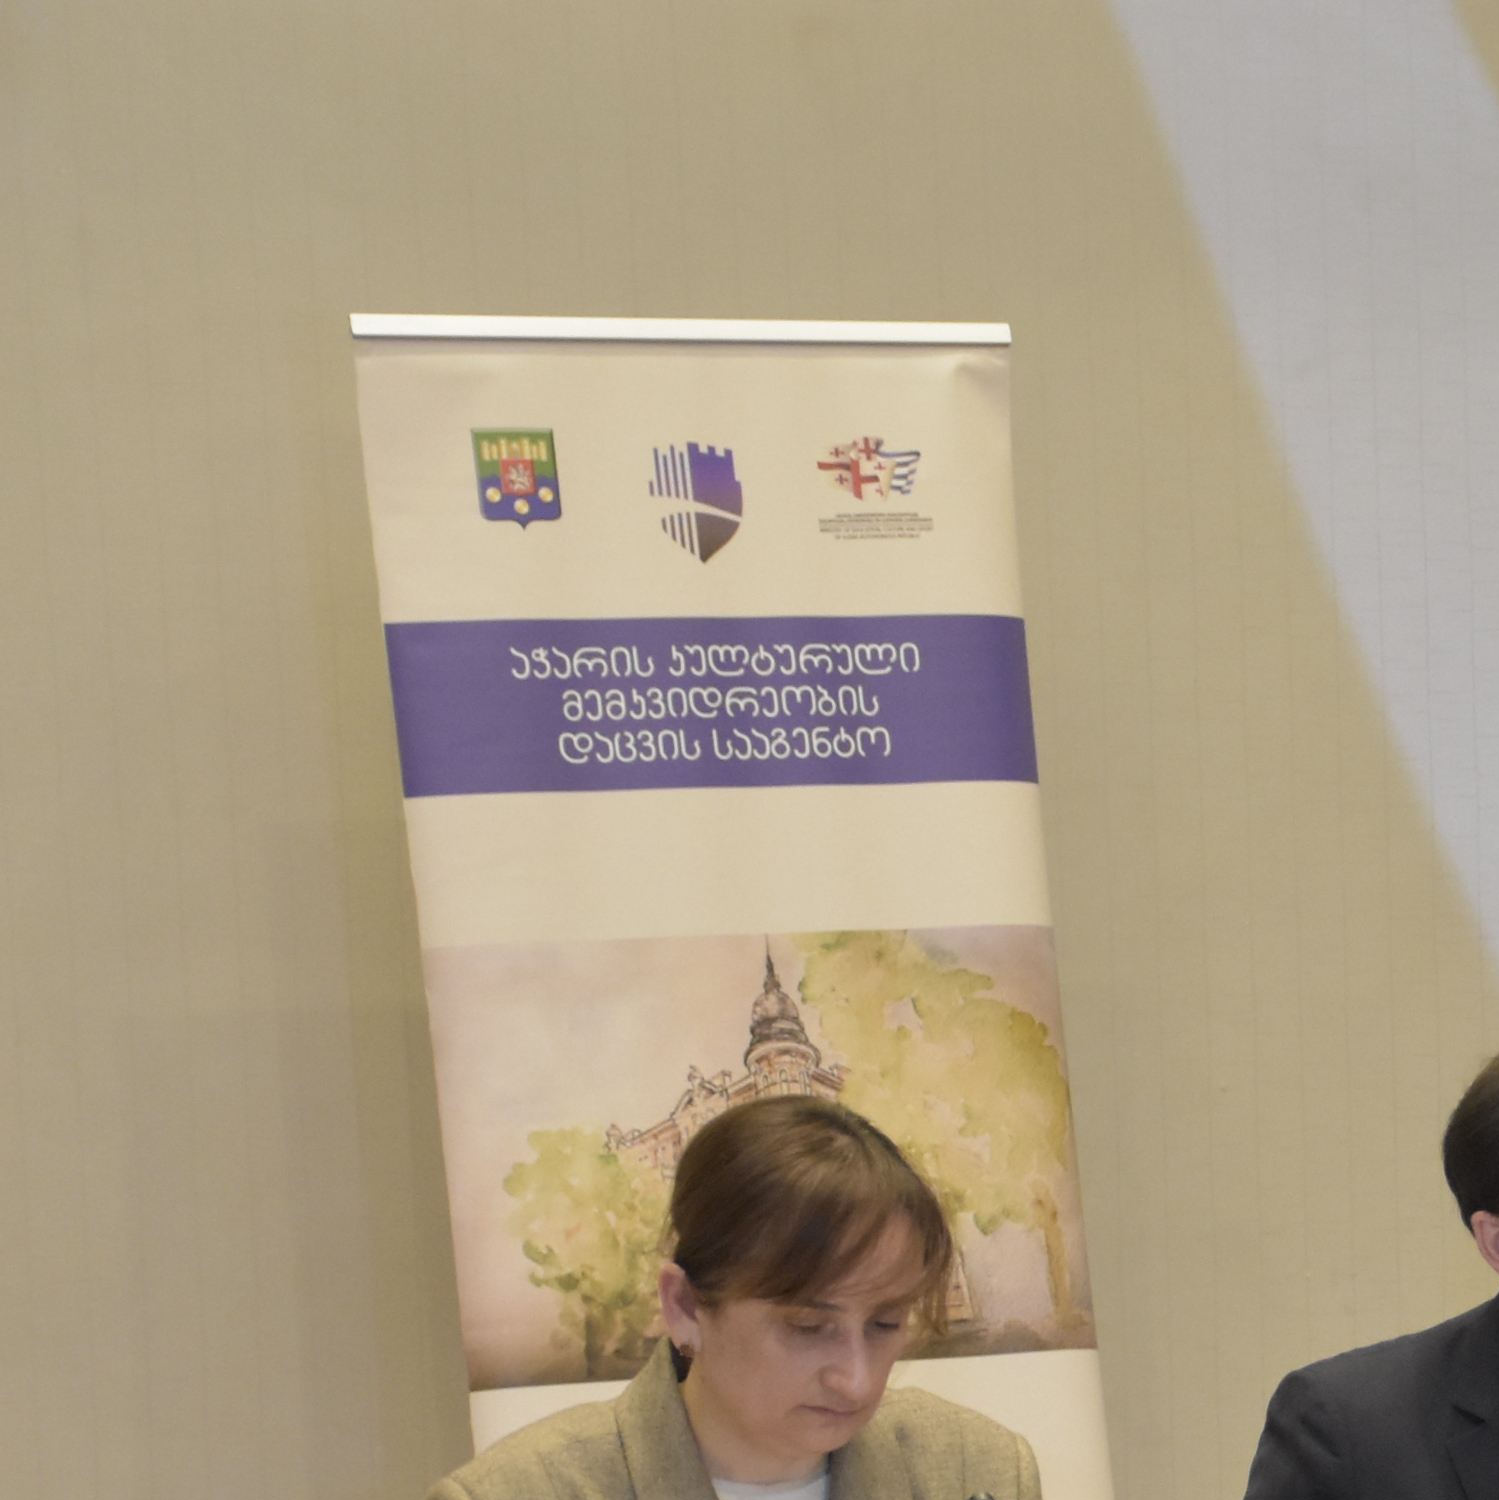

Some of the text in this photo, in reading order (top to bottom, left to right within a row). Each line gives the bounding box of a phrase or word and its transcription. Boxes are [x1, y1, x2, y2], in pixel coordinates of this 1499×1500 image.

[509, 642, 921, 680] აჭარის კულტურული
[562, 684, 880, 722] მემკვიდრეობის
[558, 726, 892, 764] დაცვის სააგენტო
